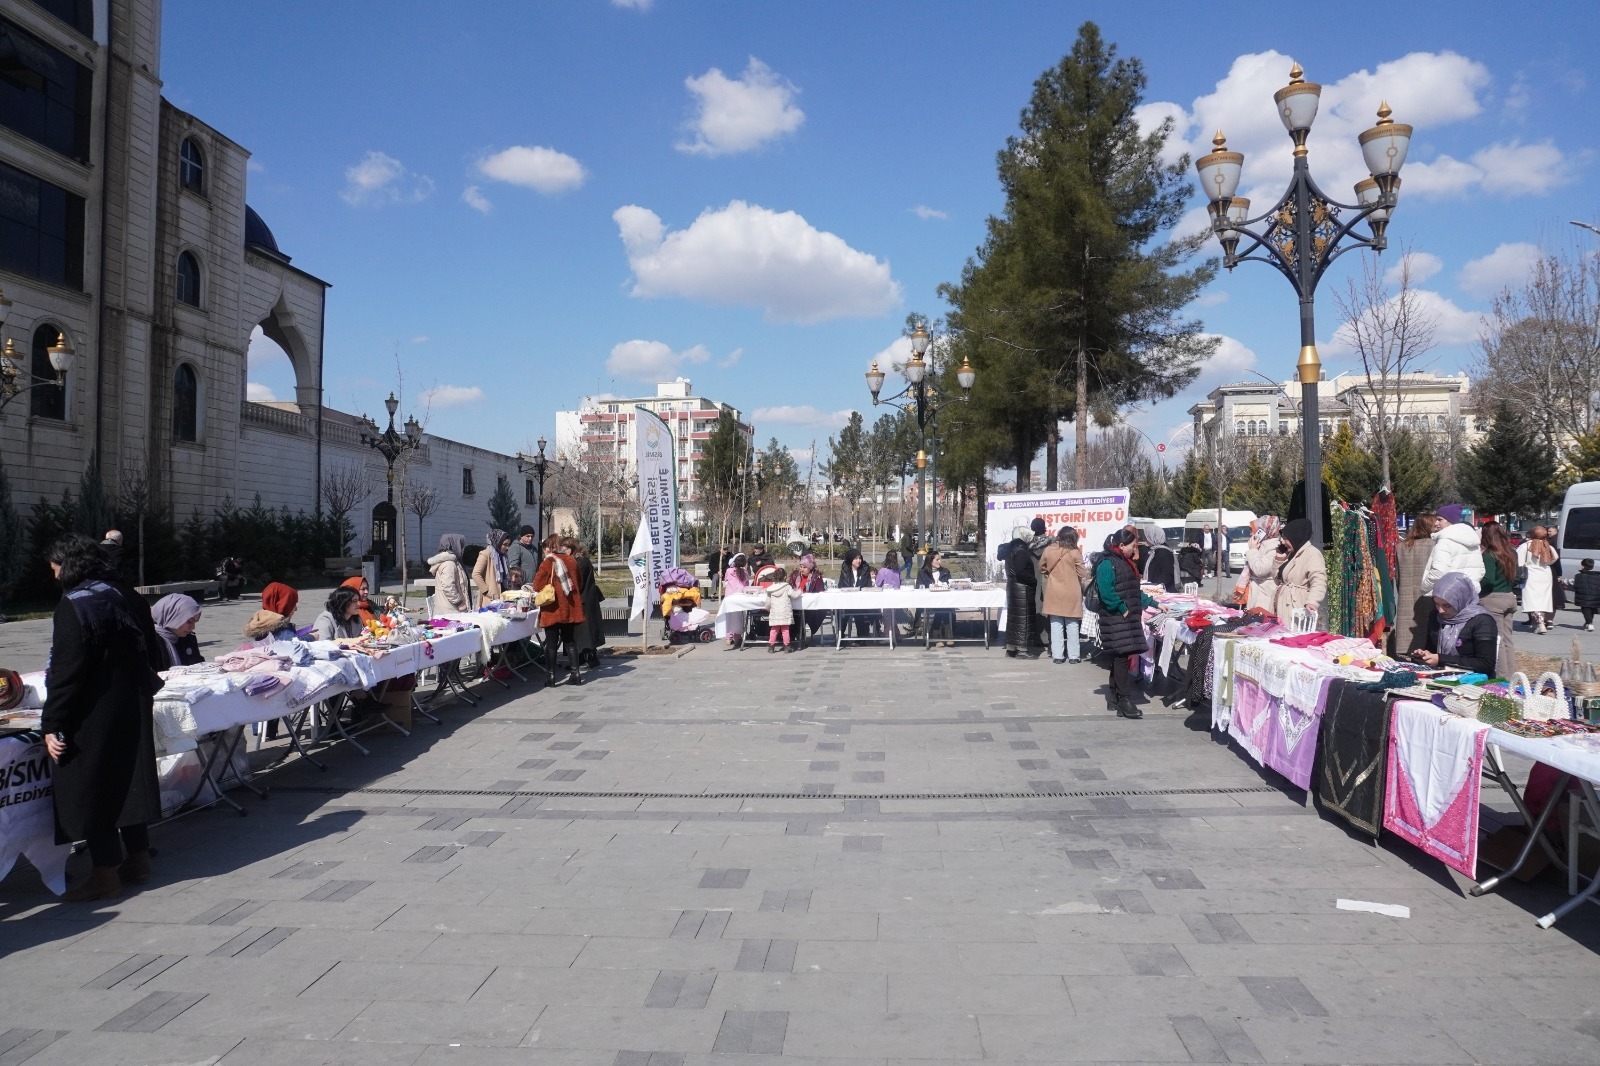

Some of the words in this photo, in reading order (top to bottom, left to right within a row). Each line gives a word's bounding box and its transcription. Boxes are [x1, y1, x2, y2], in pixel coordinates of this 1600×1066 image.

[1088, 512, 1112, 522] KED
[1115, 508, 1124, 520] Û
[0, 756, 50, 791] BİSM
